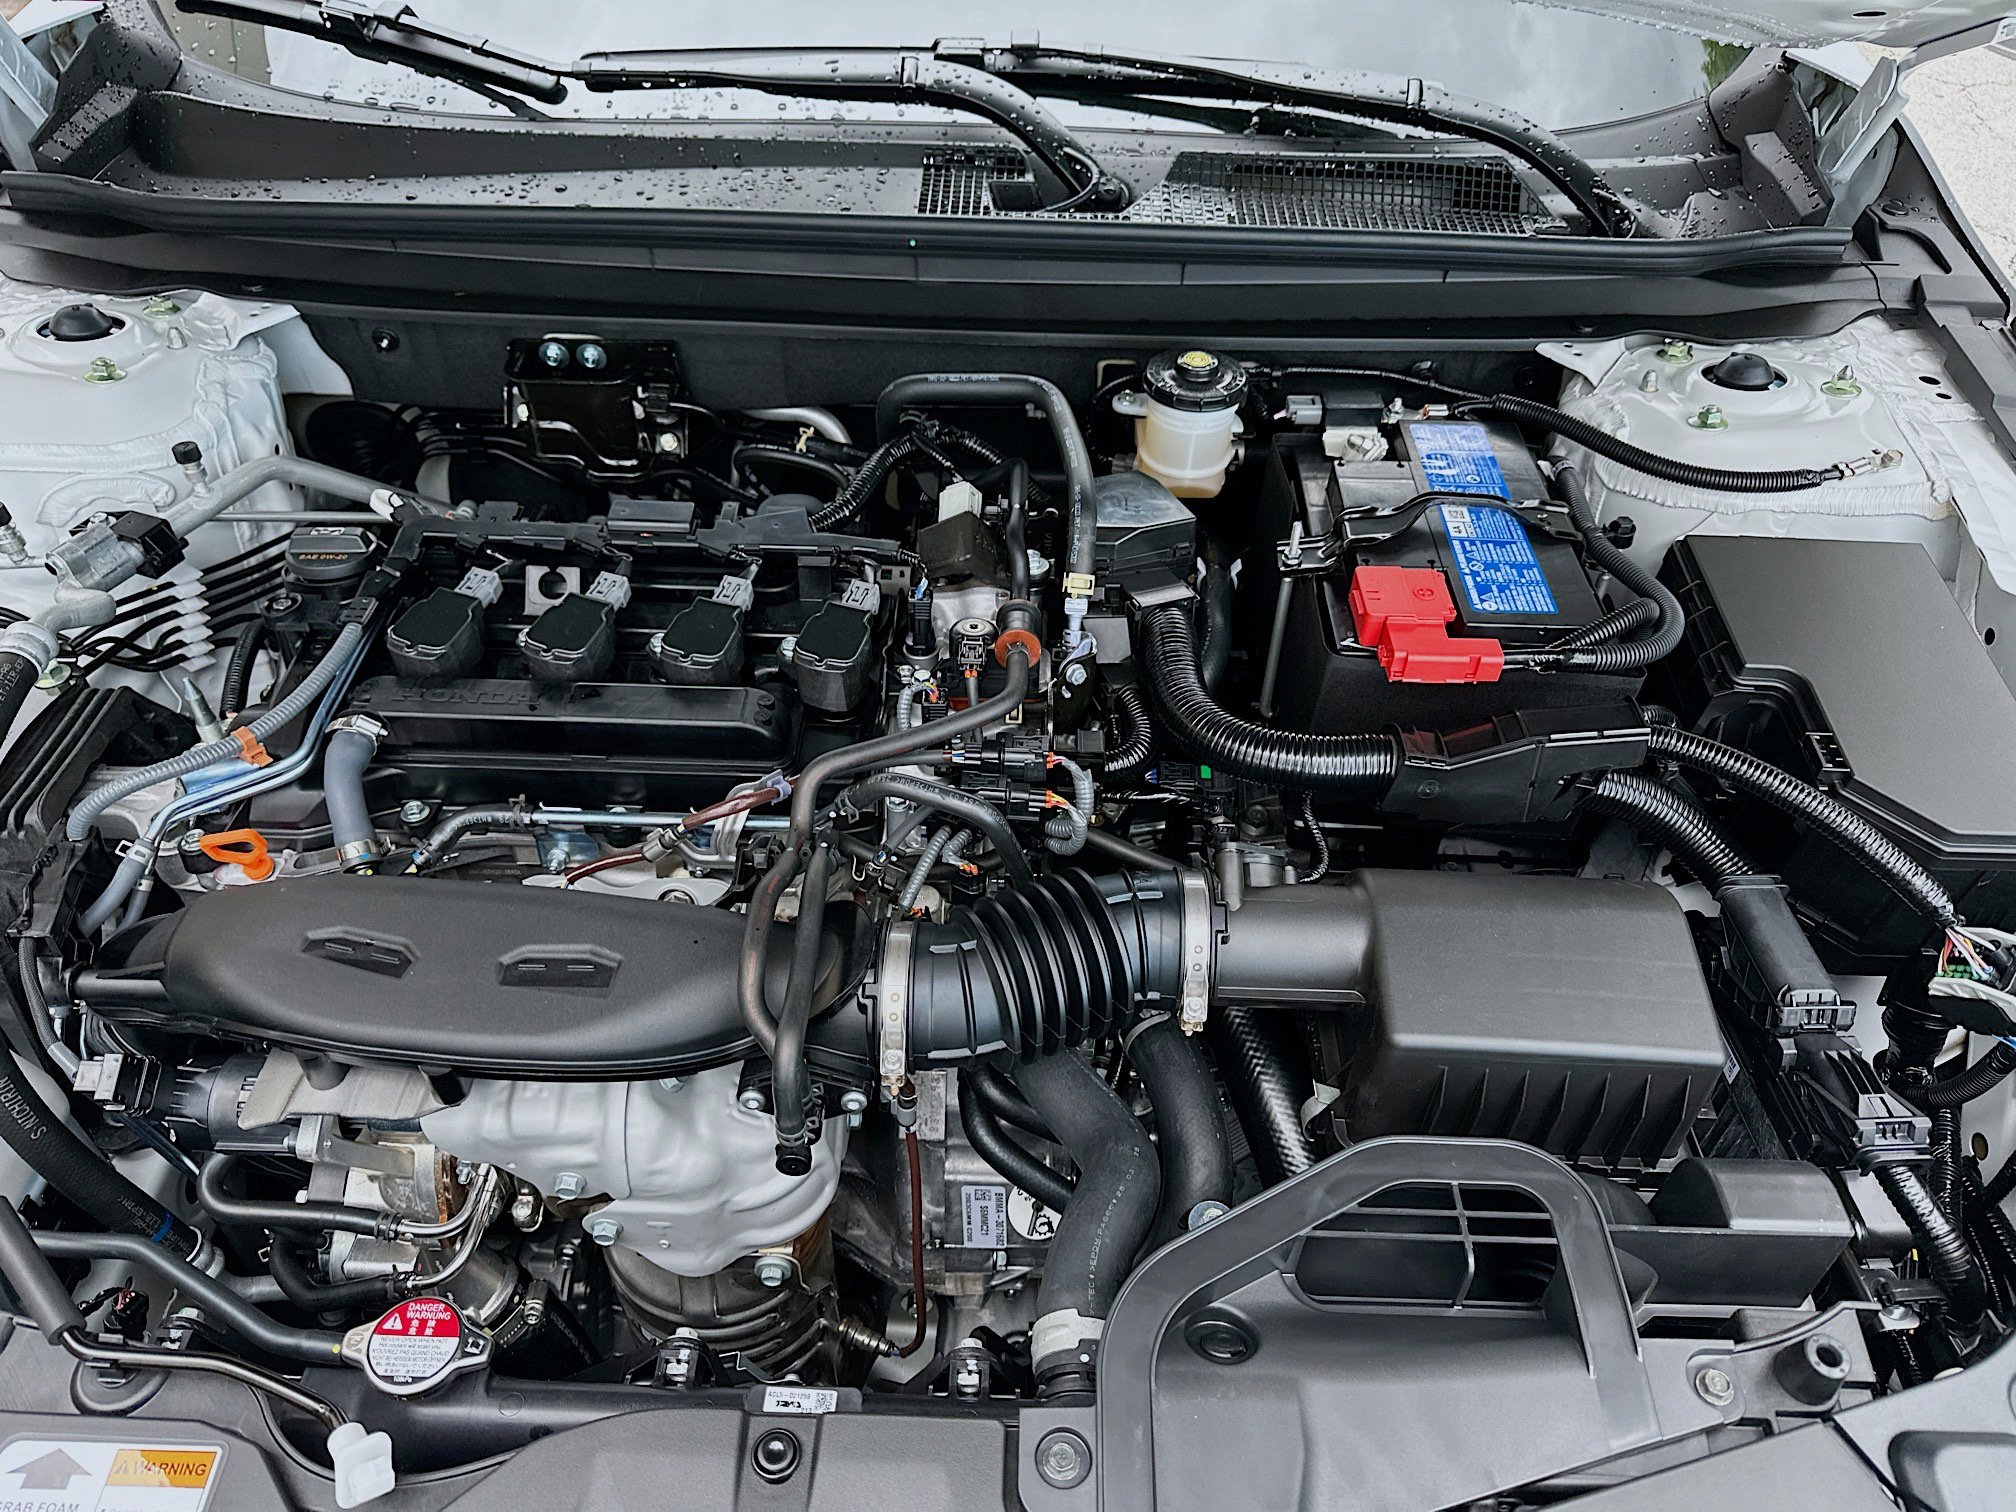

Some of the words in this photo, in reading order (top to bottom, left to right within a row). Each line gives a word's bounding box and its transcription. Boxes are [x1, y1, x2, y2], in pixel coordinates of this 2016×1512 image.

[391, 687, 541, 706] HONDA
[408, 1302, 445, 1311] DANGER
[406, 1311, 451, 1320] WARNUNG
[133, 1461, 208, 1477] WARNING
[37, 1502, 80, 1512] FOAM
